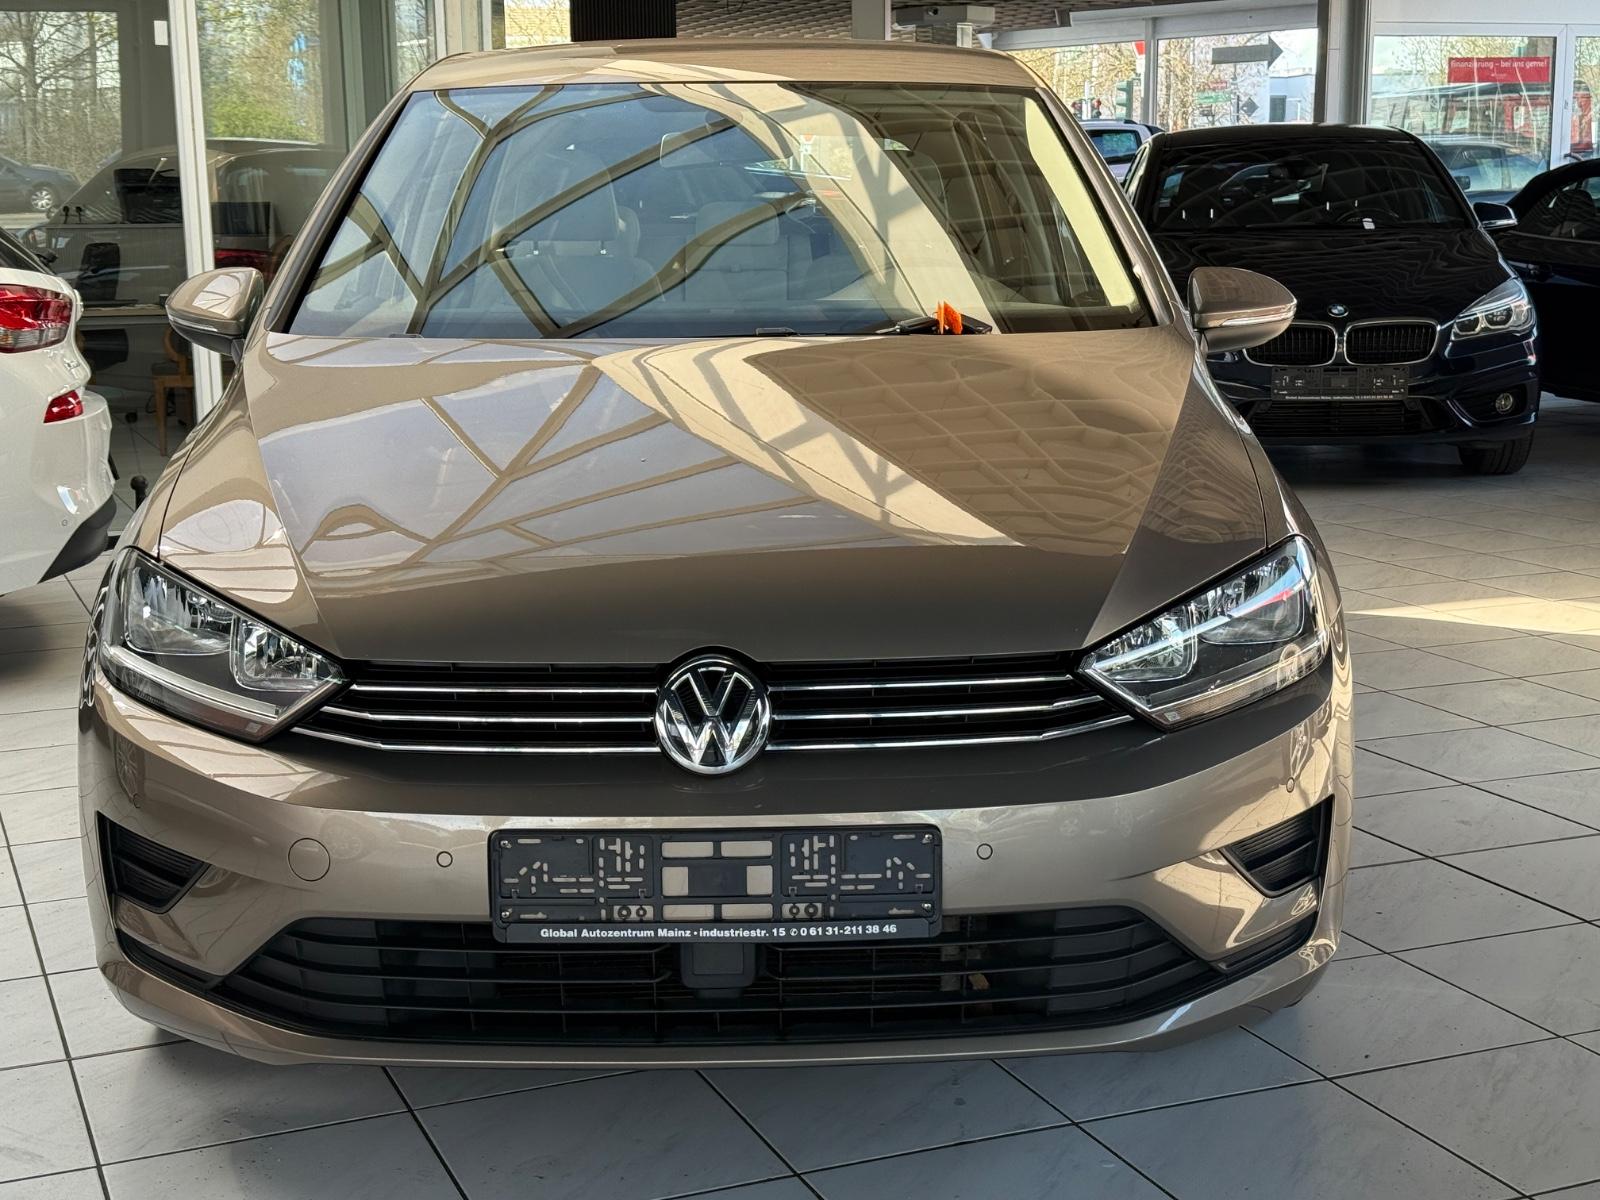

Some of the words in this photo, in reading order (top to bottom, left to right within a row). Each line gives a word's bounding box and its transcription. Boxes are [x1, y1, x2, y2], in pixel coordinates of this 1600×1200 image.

[540, 928, 578, 938] Global
[581, 928, 655, 938] Autozentrum
[658, 928, 691, 938] Mainz
[772, 927, 786, 937] 15
[865, 925, 880, 934] 38
[882, 924, 897, 933] 46
